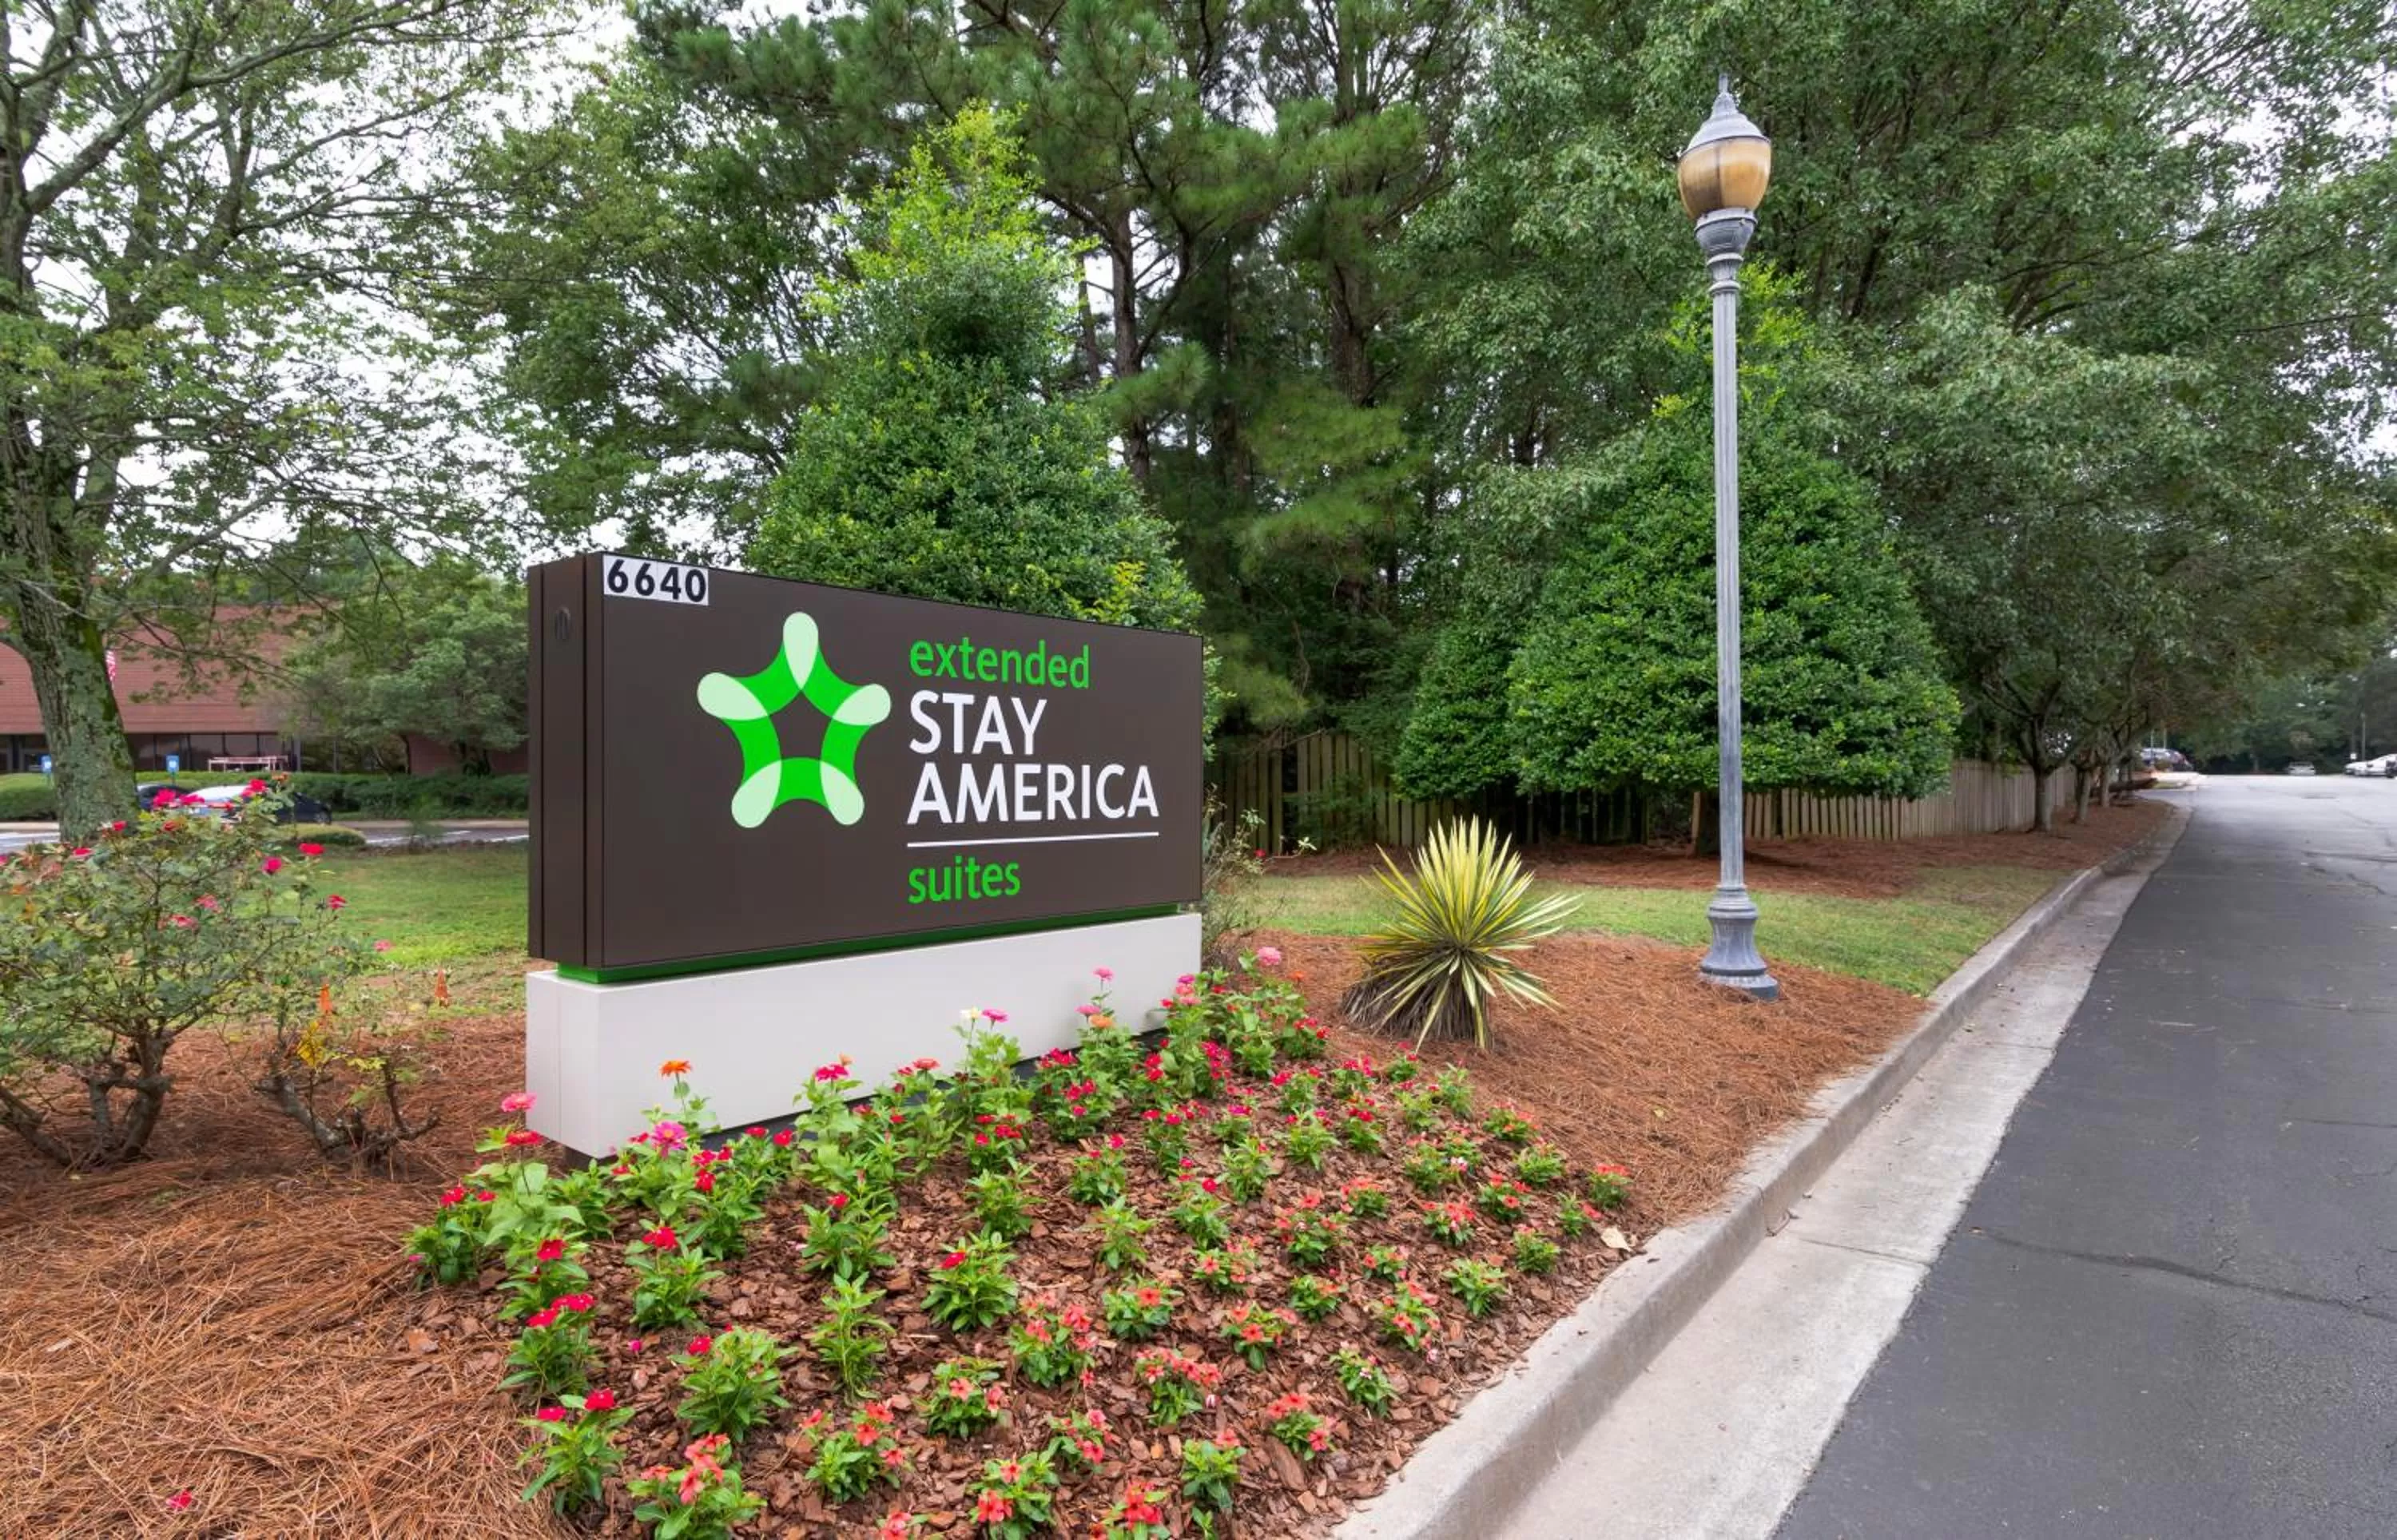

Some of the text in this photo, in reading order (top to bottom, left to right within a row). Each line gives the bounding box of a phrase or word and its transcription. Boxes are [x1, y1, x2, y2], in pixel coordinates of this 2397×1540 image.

[607, 559, 707, 603] 6640
[909, 637, 1090, 689] extended
[908, 689, 1047, 756] STAY
[906, 761, 1160, 825] AMERICA
[908, 855, 1021, 904] suites
